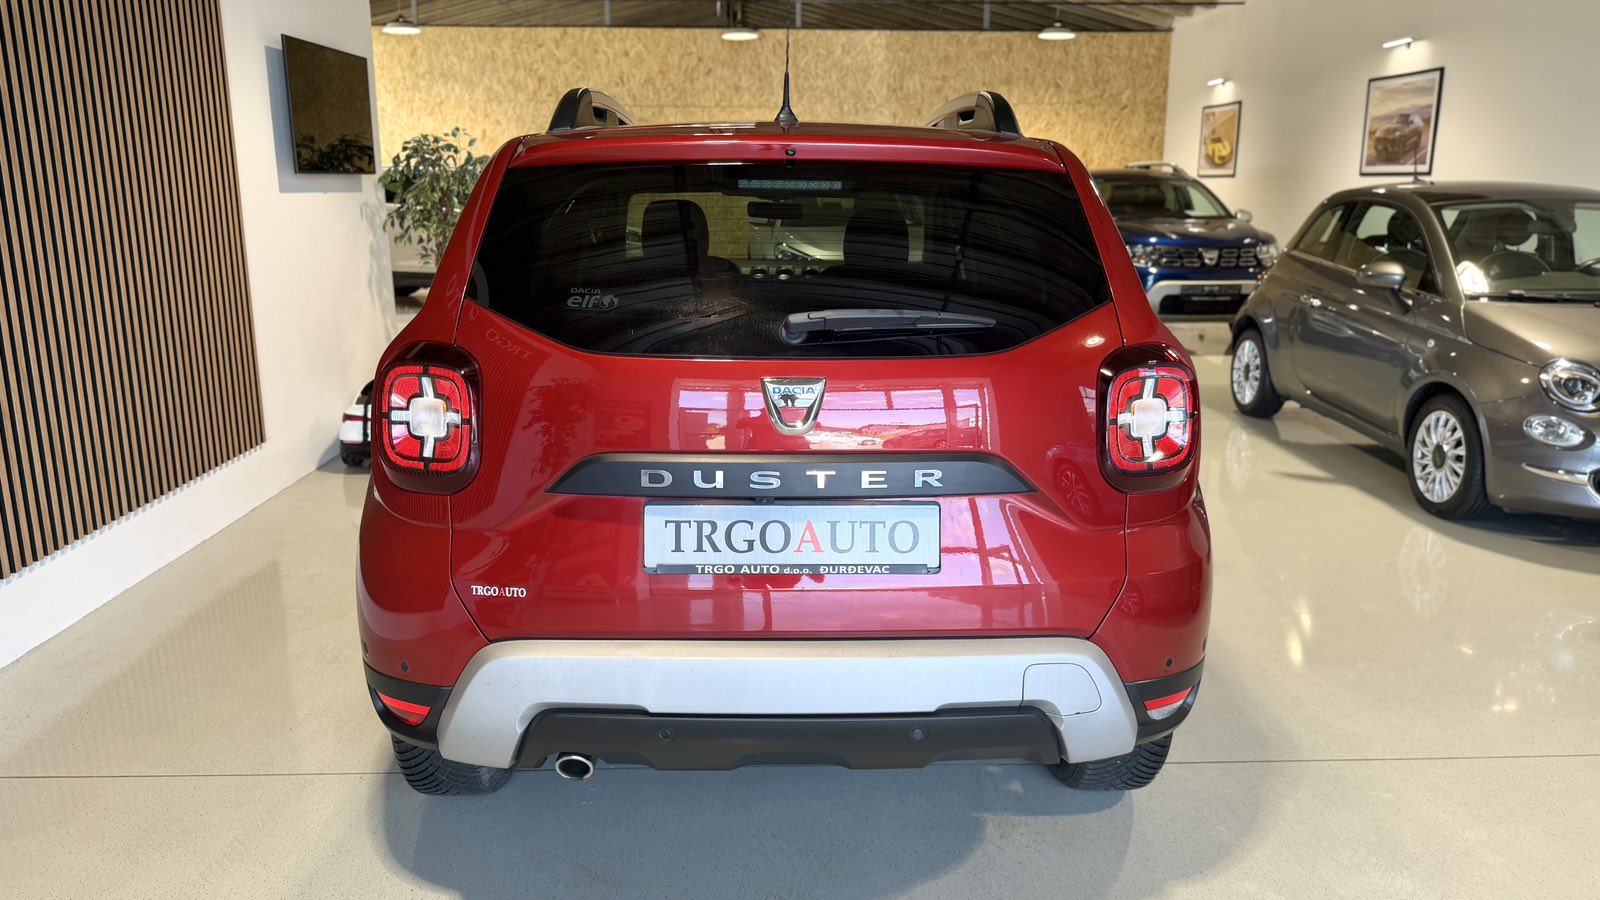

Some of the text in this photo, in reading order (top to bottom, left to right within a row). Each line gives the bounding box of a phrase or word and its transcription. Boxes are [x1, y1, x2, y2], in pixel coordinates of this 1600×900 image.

[566, 294, 601, 308] elf
[772, 386, 816, 395] DACIA
[640, 469, 944, 489] DUSTER
[664, 519, 920, 554] TRGOAUTO
[695, 564, 890, 574] TRGO AUTO d.o.o. ĐURĐEVAC
[470, 585, 527, 598] TRGOAUTO
